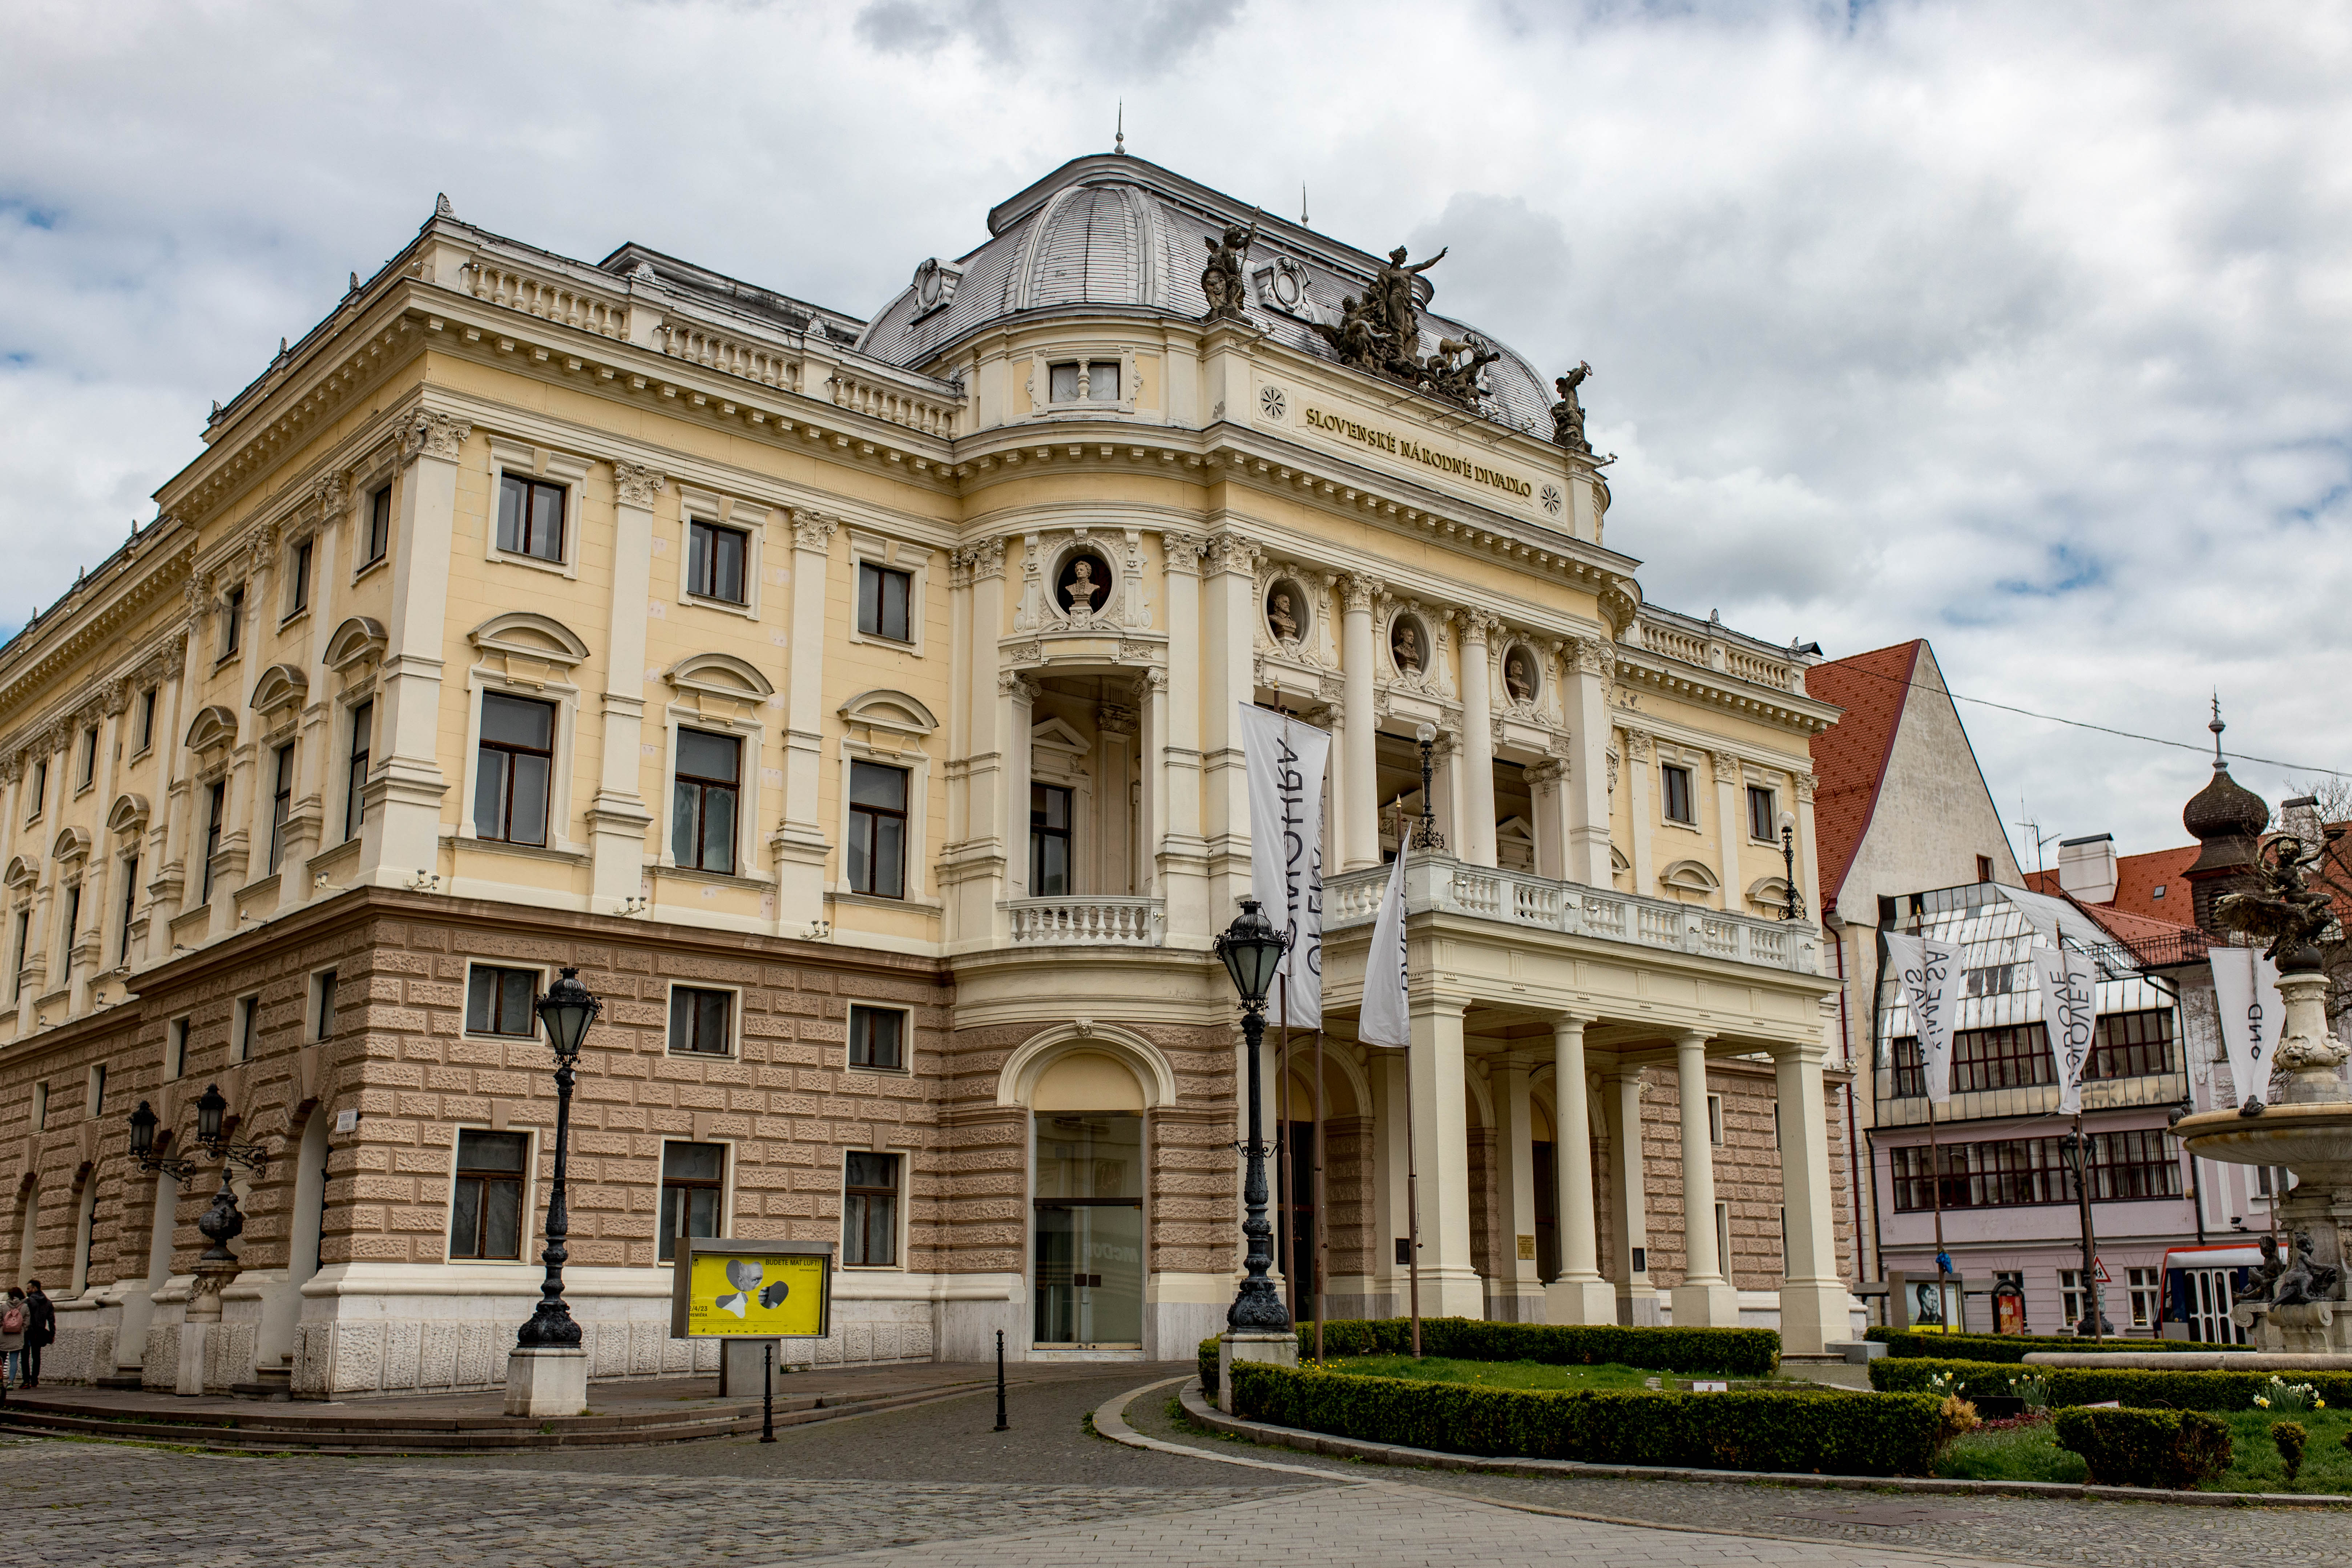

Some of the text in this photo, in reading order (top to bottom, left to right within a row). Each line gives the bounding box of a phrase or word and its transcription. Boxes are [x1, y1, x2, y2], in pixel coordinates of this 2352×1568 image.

[1306, 408, 1532, 497] SLOVENSKÉ NÁRODNÉ DIVADLO
